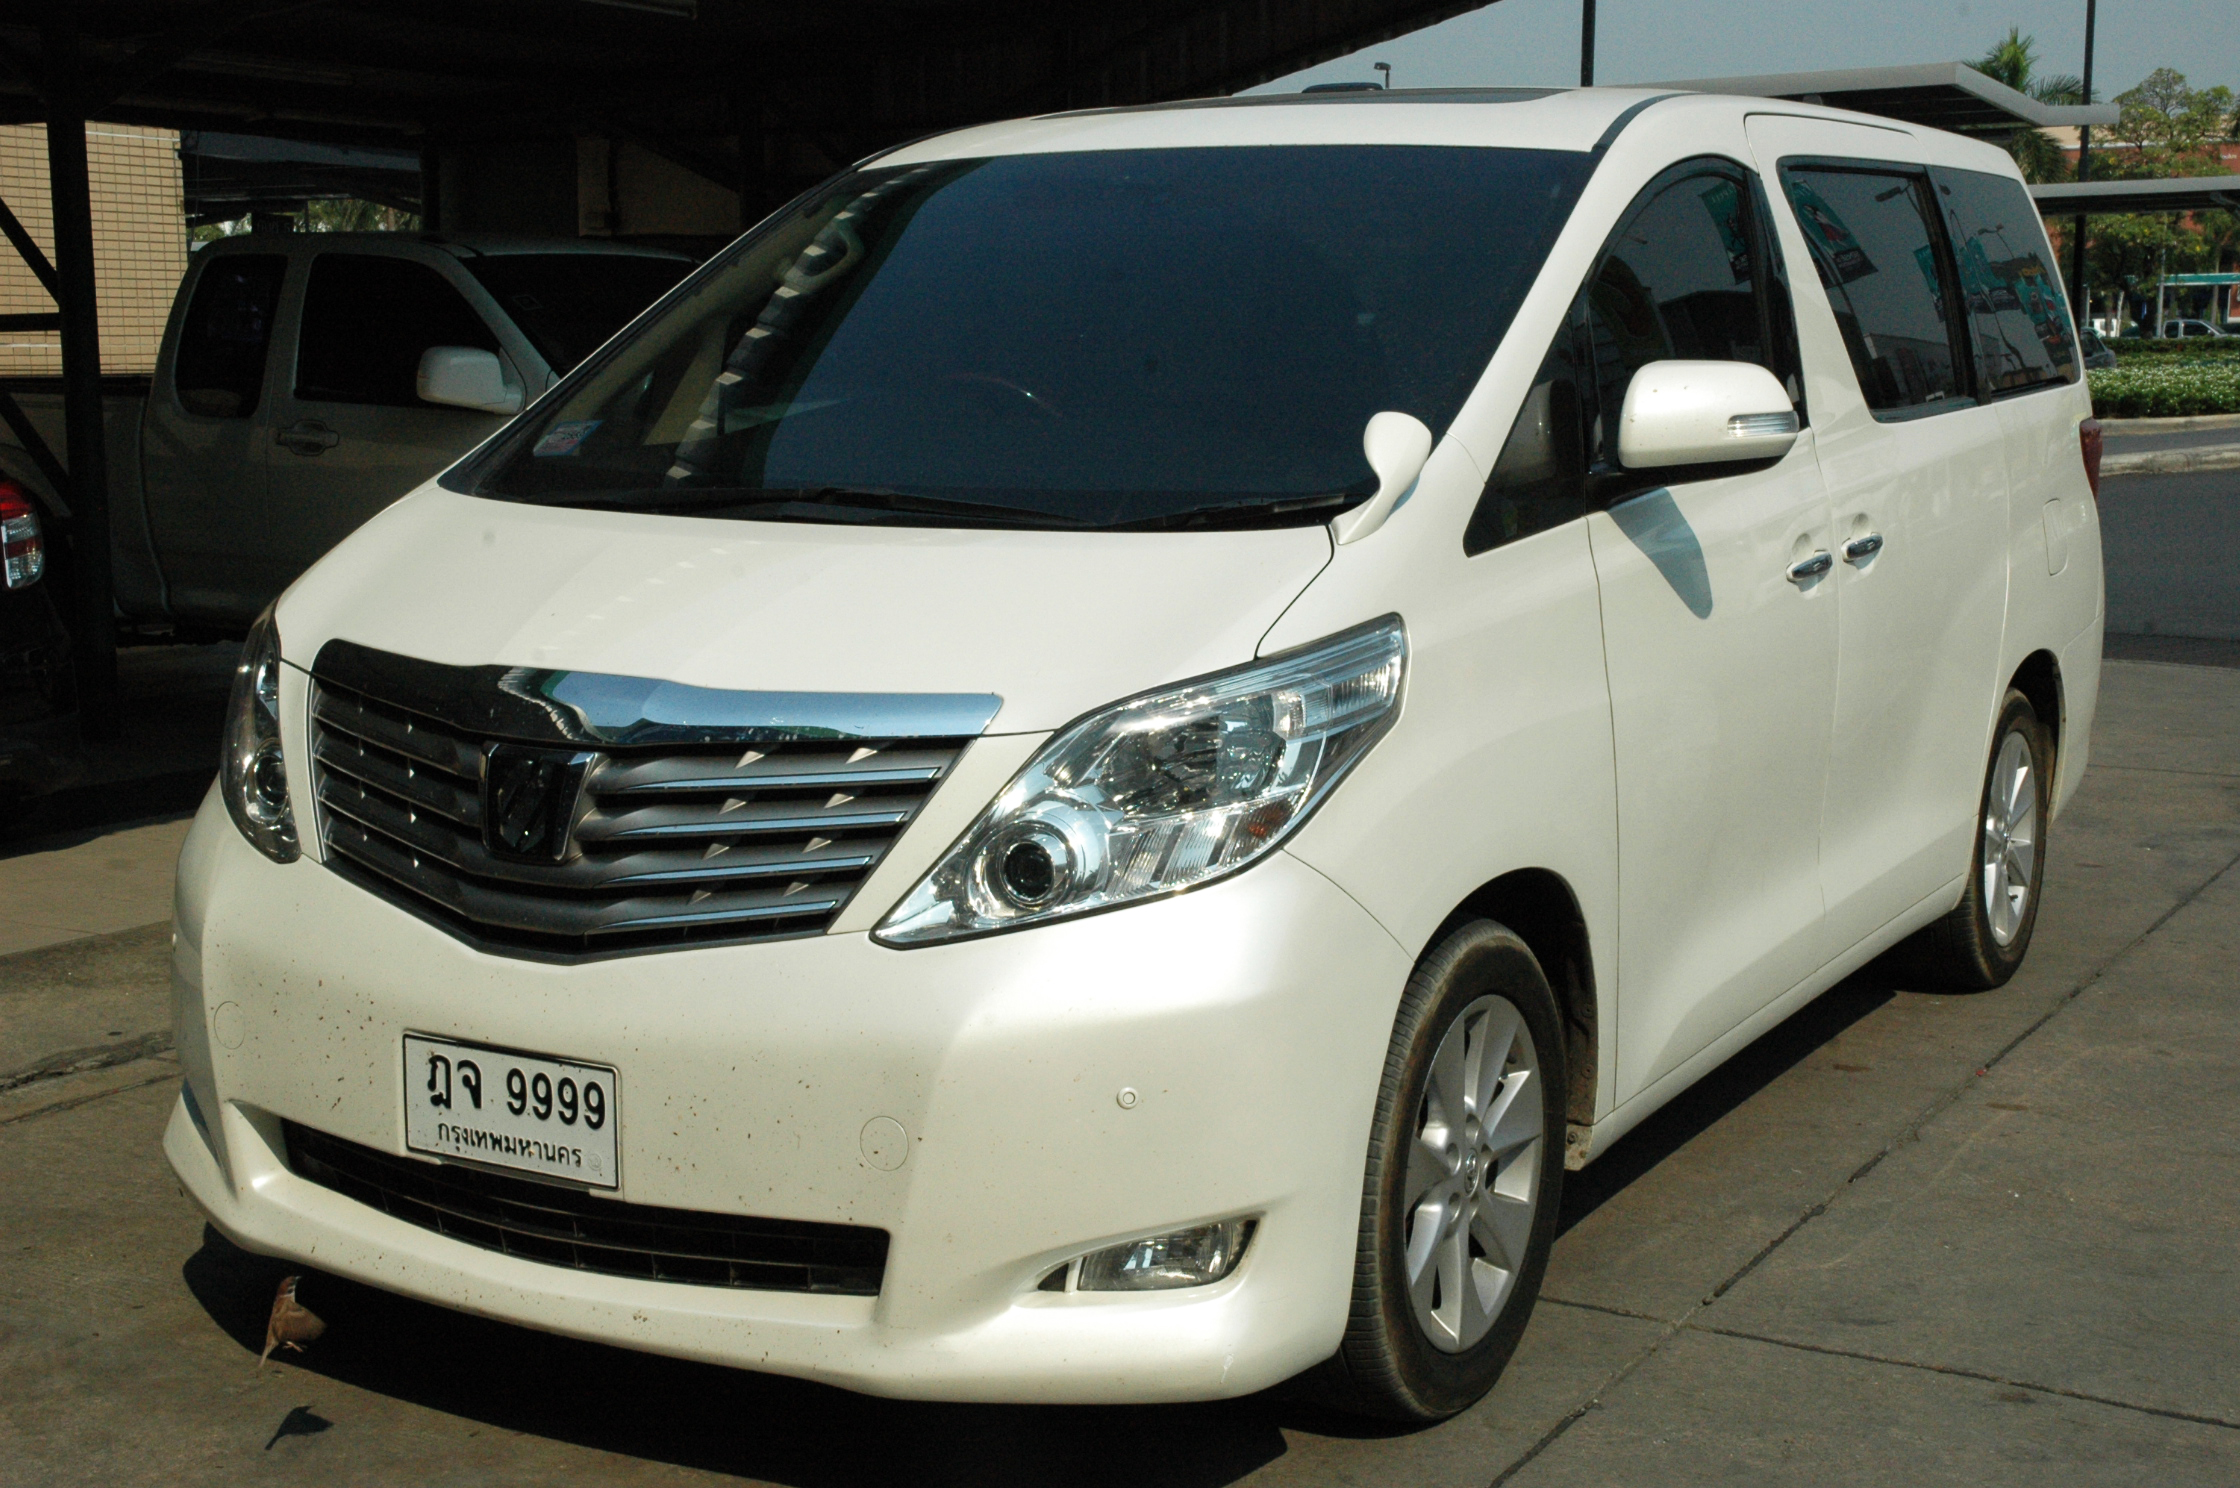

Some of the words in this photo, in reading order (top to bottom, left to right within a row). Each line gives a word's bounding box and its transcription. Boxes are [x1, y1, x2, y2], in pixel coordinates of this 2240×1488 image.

[427, 1054, 482, 1110] ฎจ
[506, 1067, 606, 1130] 9999
[438, 1122, 583, 1168] กรุงเทพมหานคร
